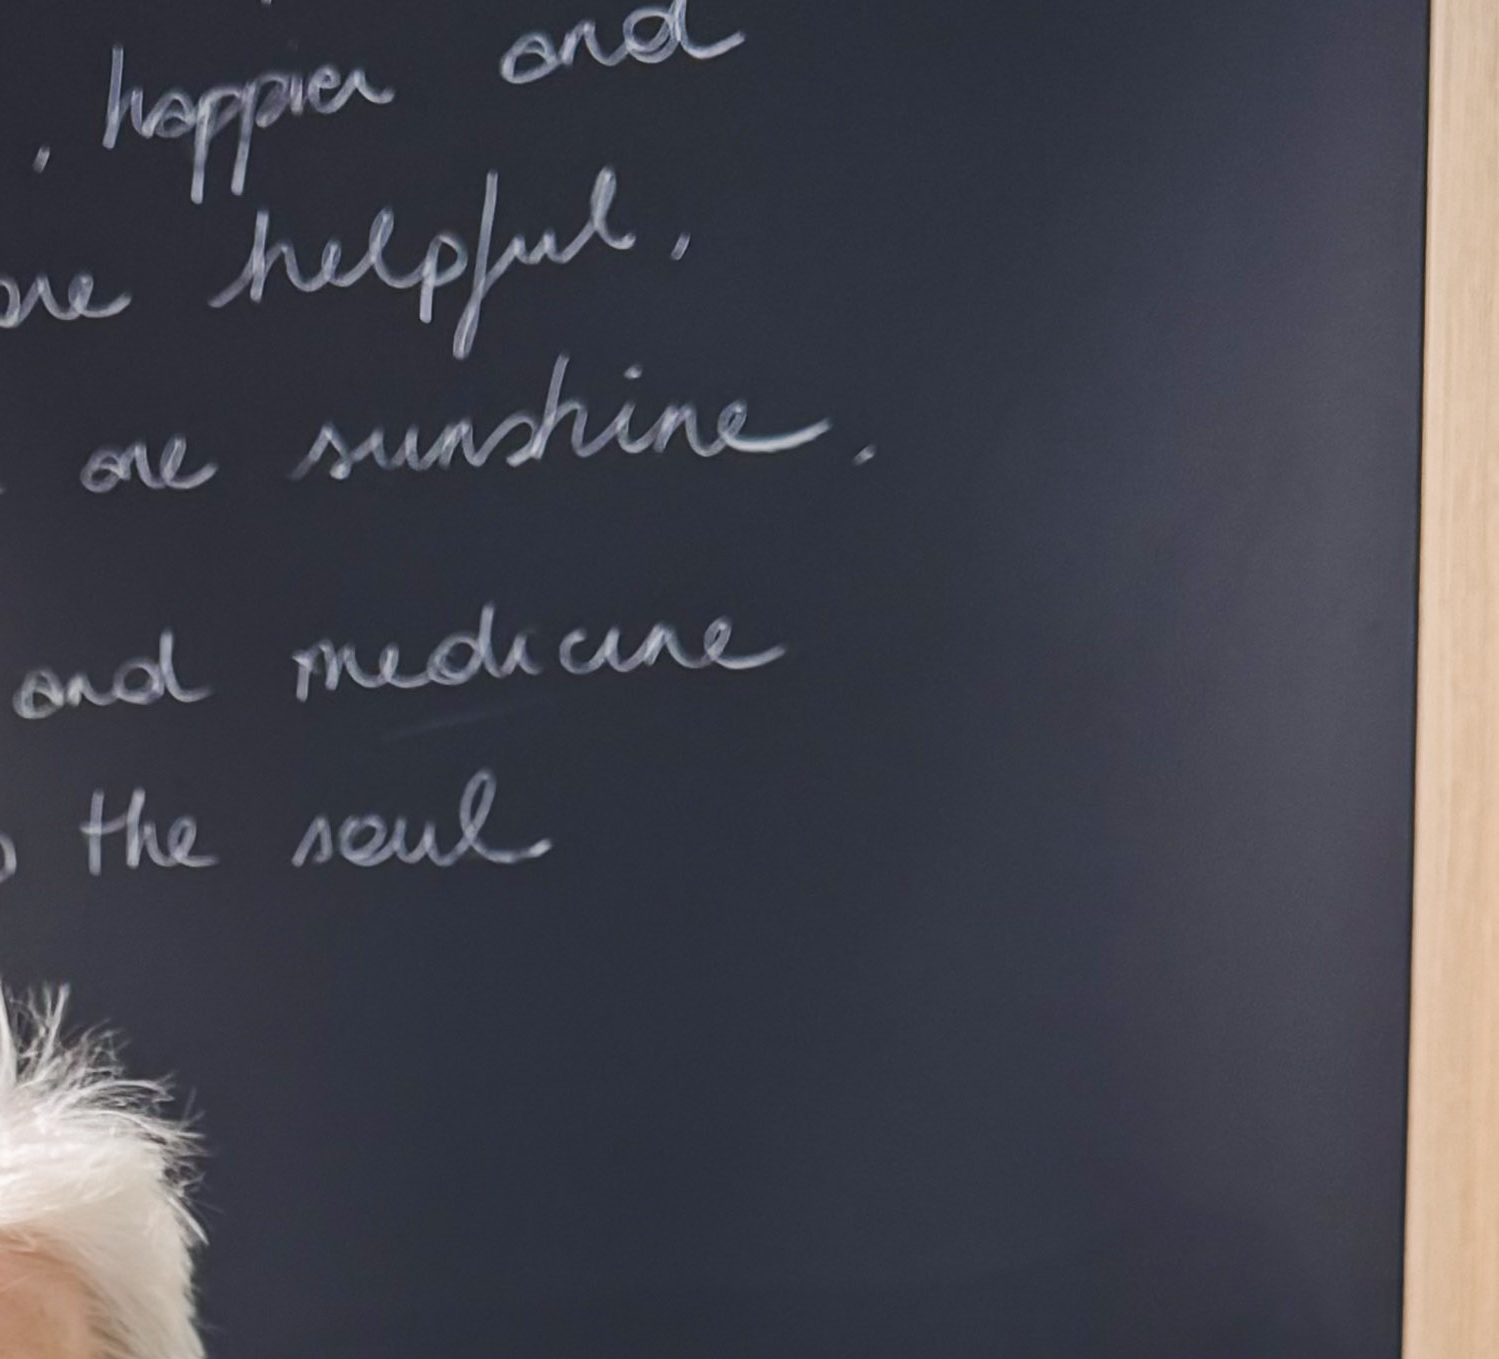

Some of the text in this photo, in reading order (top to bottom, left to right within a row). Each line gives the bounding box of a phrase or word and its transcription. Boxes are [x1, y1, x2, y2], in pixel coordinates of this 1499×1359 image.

[102, 44, 395, 204] happier
[499, 0, 747, 85] and
[80, 435, 219, 493] are
[13, 629, 212, 720] and
[290, 602, 787, 702] medicine
[79, 787, 219, 876] the
[291, 768, 553, 867] soul
